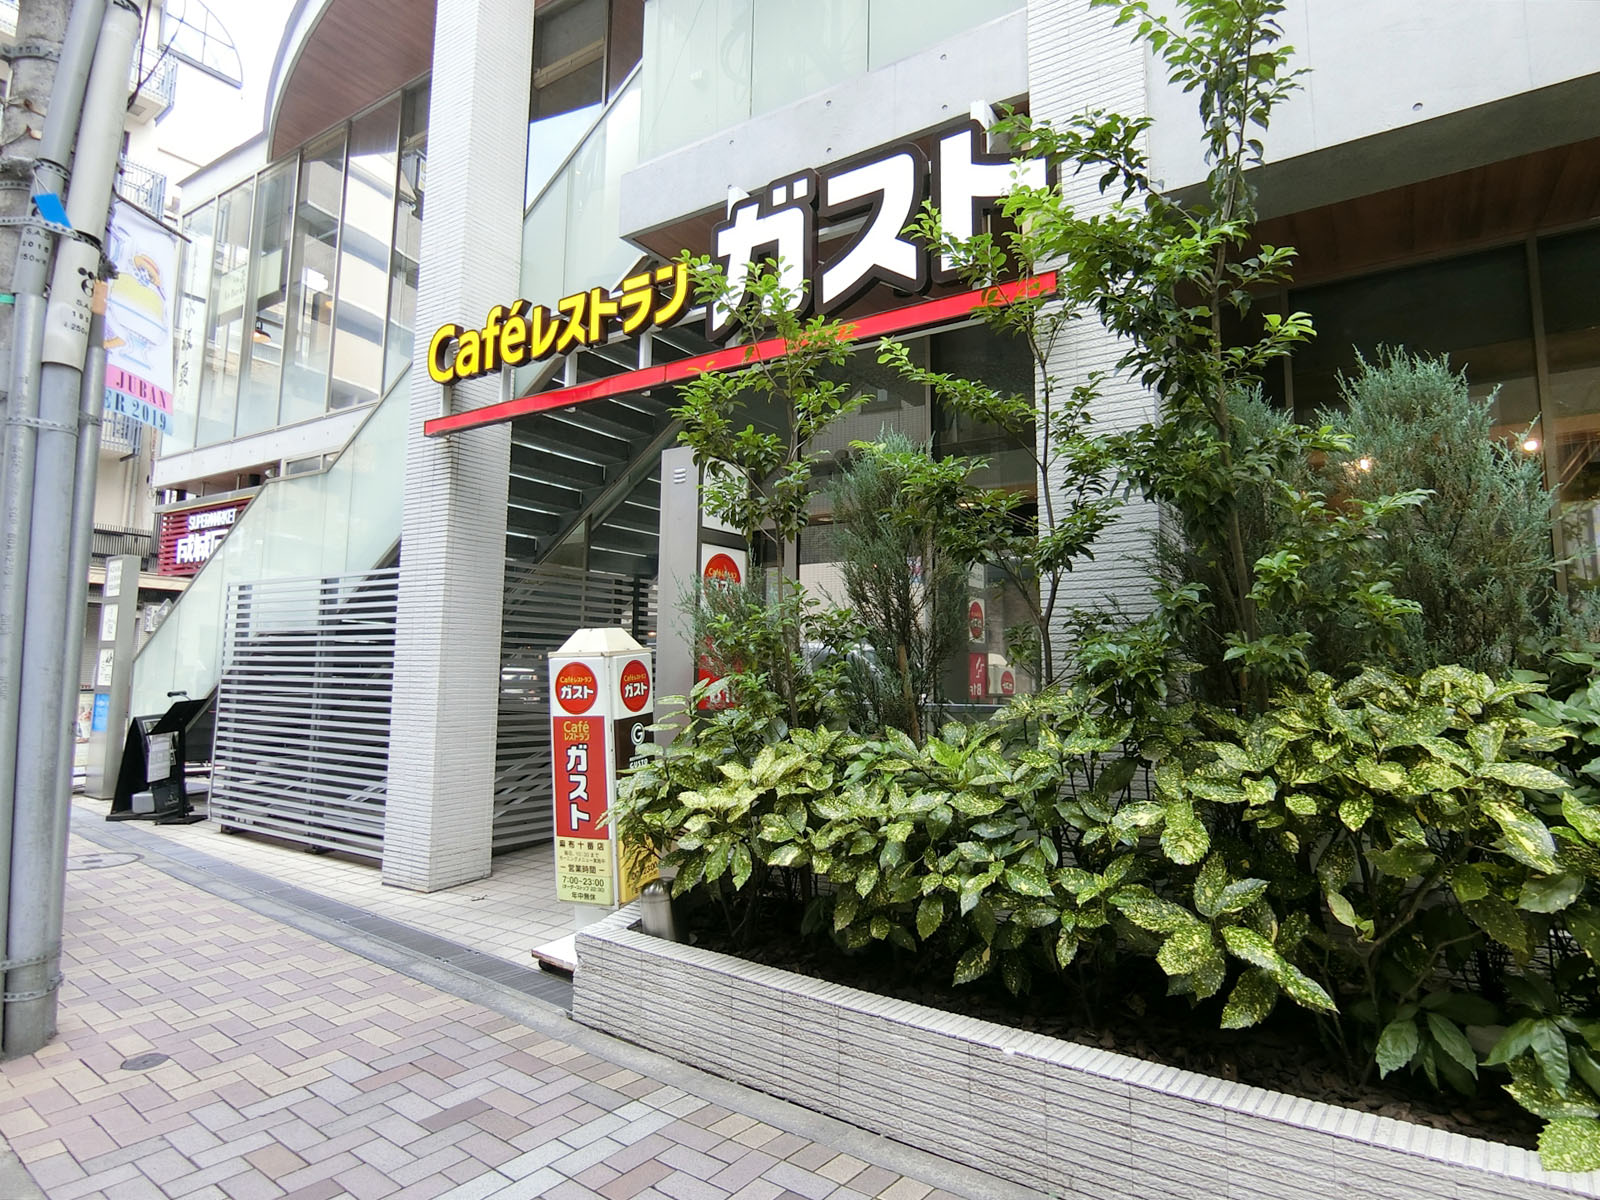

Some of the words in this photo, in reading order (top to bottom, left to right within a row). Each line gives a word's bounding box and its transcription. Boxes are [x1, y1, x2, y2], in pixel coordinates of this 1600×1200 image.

[711, 128, 1047, 331] ガスト
[116, 371, 168, 410] JUBAN
[132, 399, 167, 431] 2019
[561, 684, 594, 700] ガスト
[624, 681, 648, 698] ガスト
[563, 720, 590, 733] Café
[564, 732, 590, 741] レストラン
[566, 744, 591, 831] ガスト
[568, 864, 597, 874] 営業時間
[571, 891, 596, 900] 年中無休
